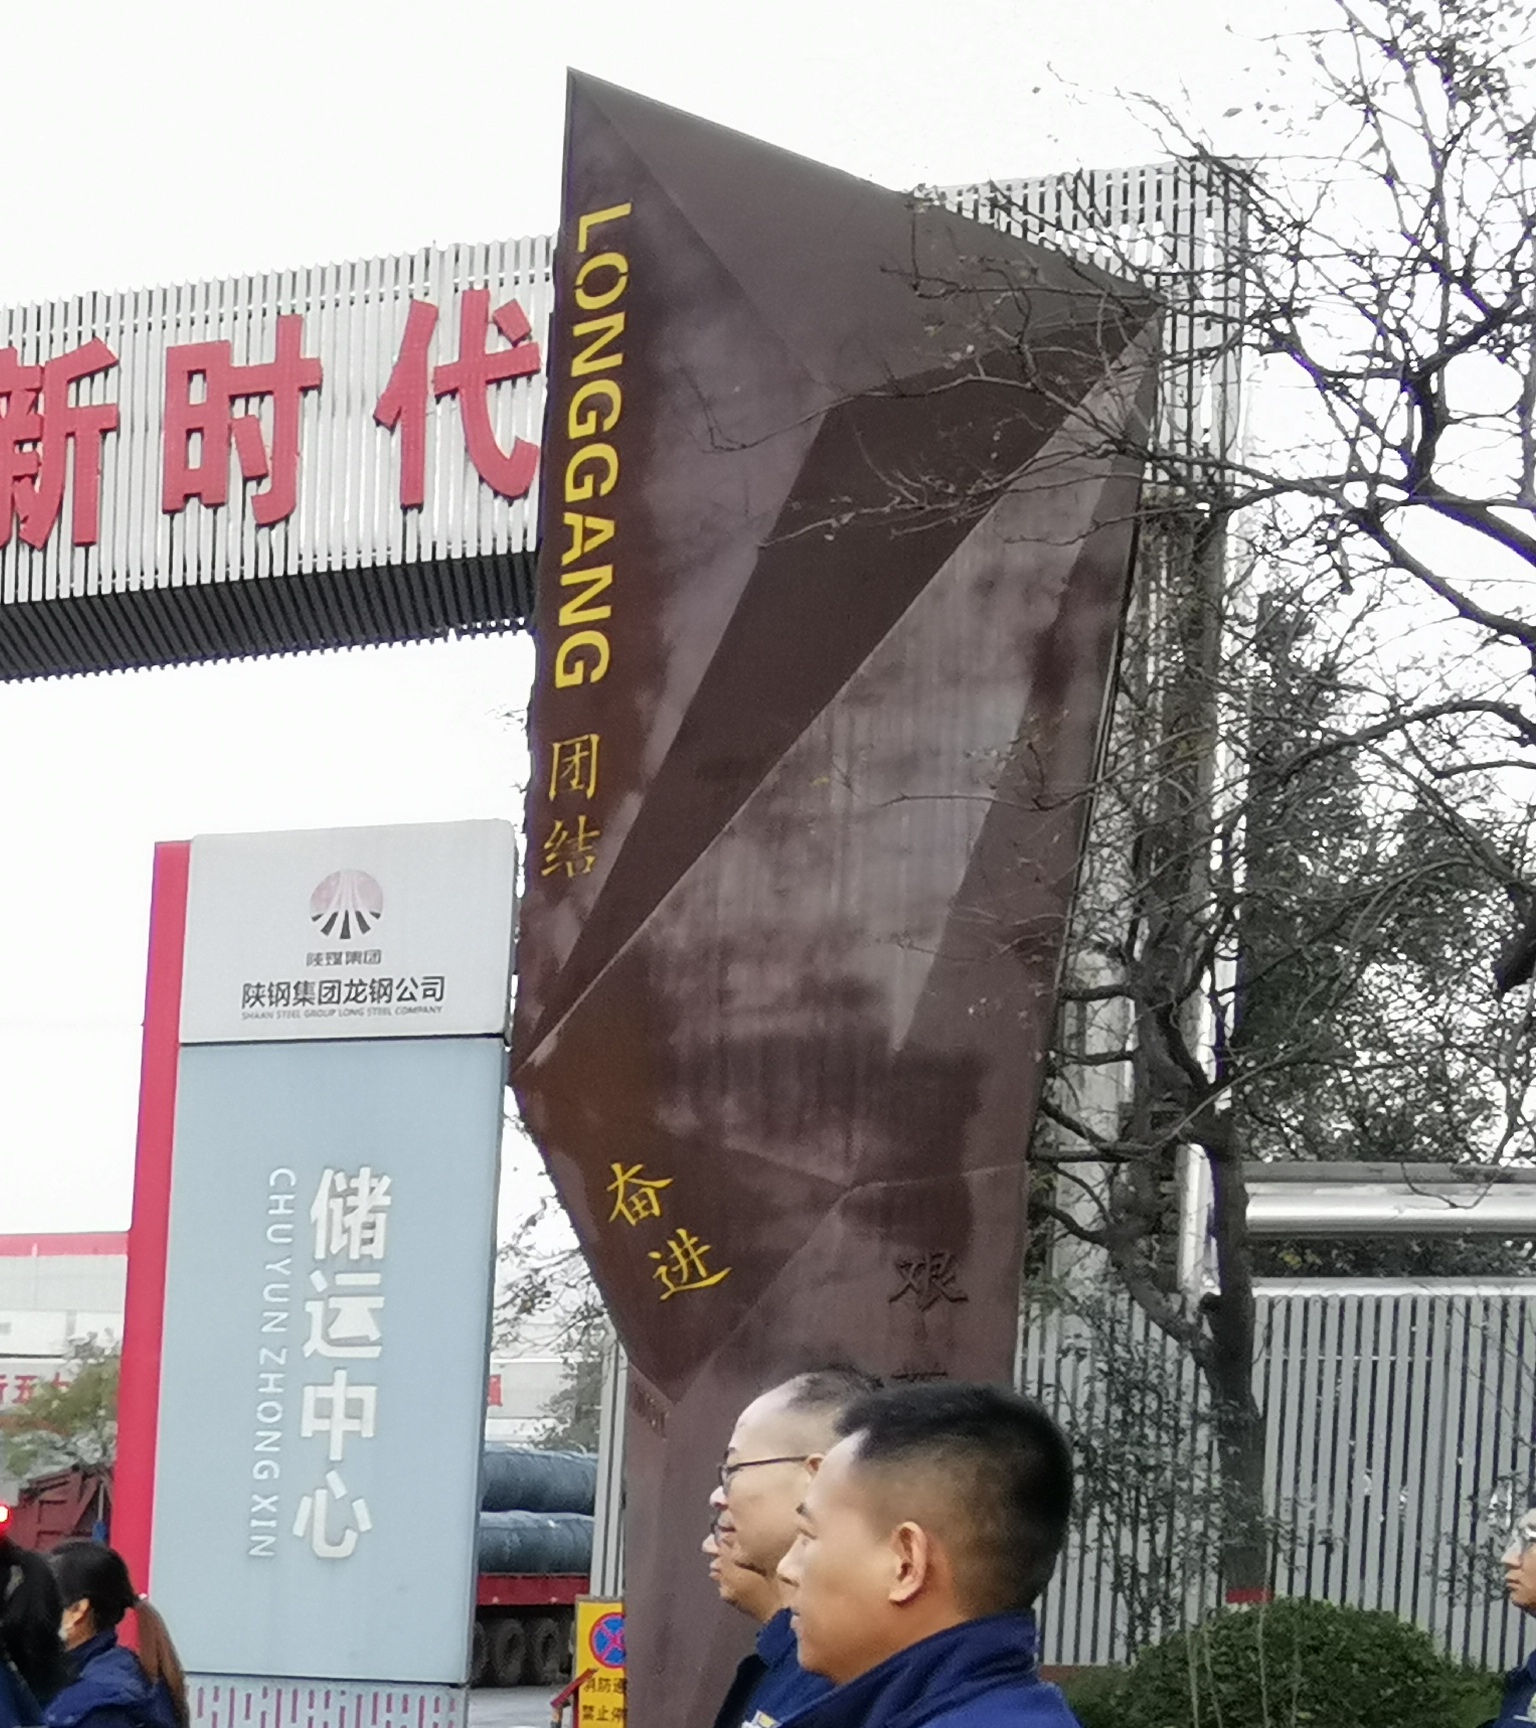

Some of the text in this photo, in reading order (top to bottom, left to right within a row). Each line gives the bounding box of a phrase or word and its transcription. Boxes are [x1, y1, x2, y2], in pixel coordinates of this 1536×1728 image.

[553, 203, 632, 690] LONGGANG
[540, 733, 601, 878] 团结
[241, 975, 445, 1010] 陕钢集团龙钢公司
[247, 1167, 297, 1558] CHU YUN ZHONG XIN
[292, 1166, 392, 1560] 储运中心
[608, 1162, 731, 1301] 奋进
